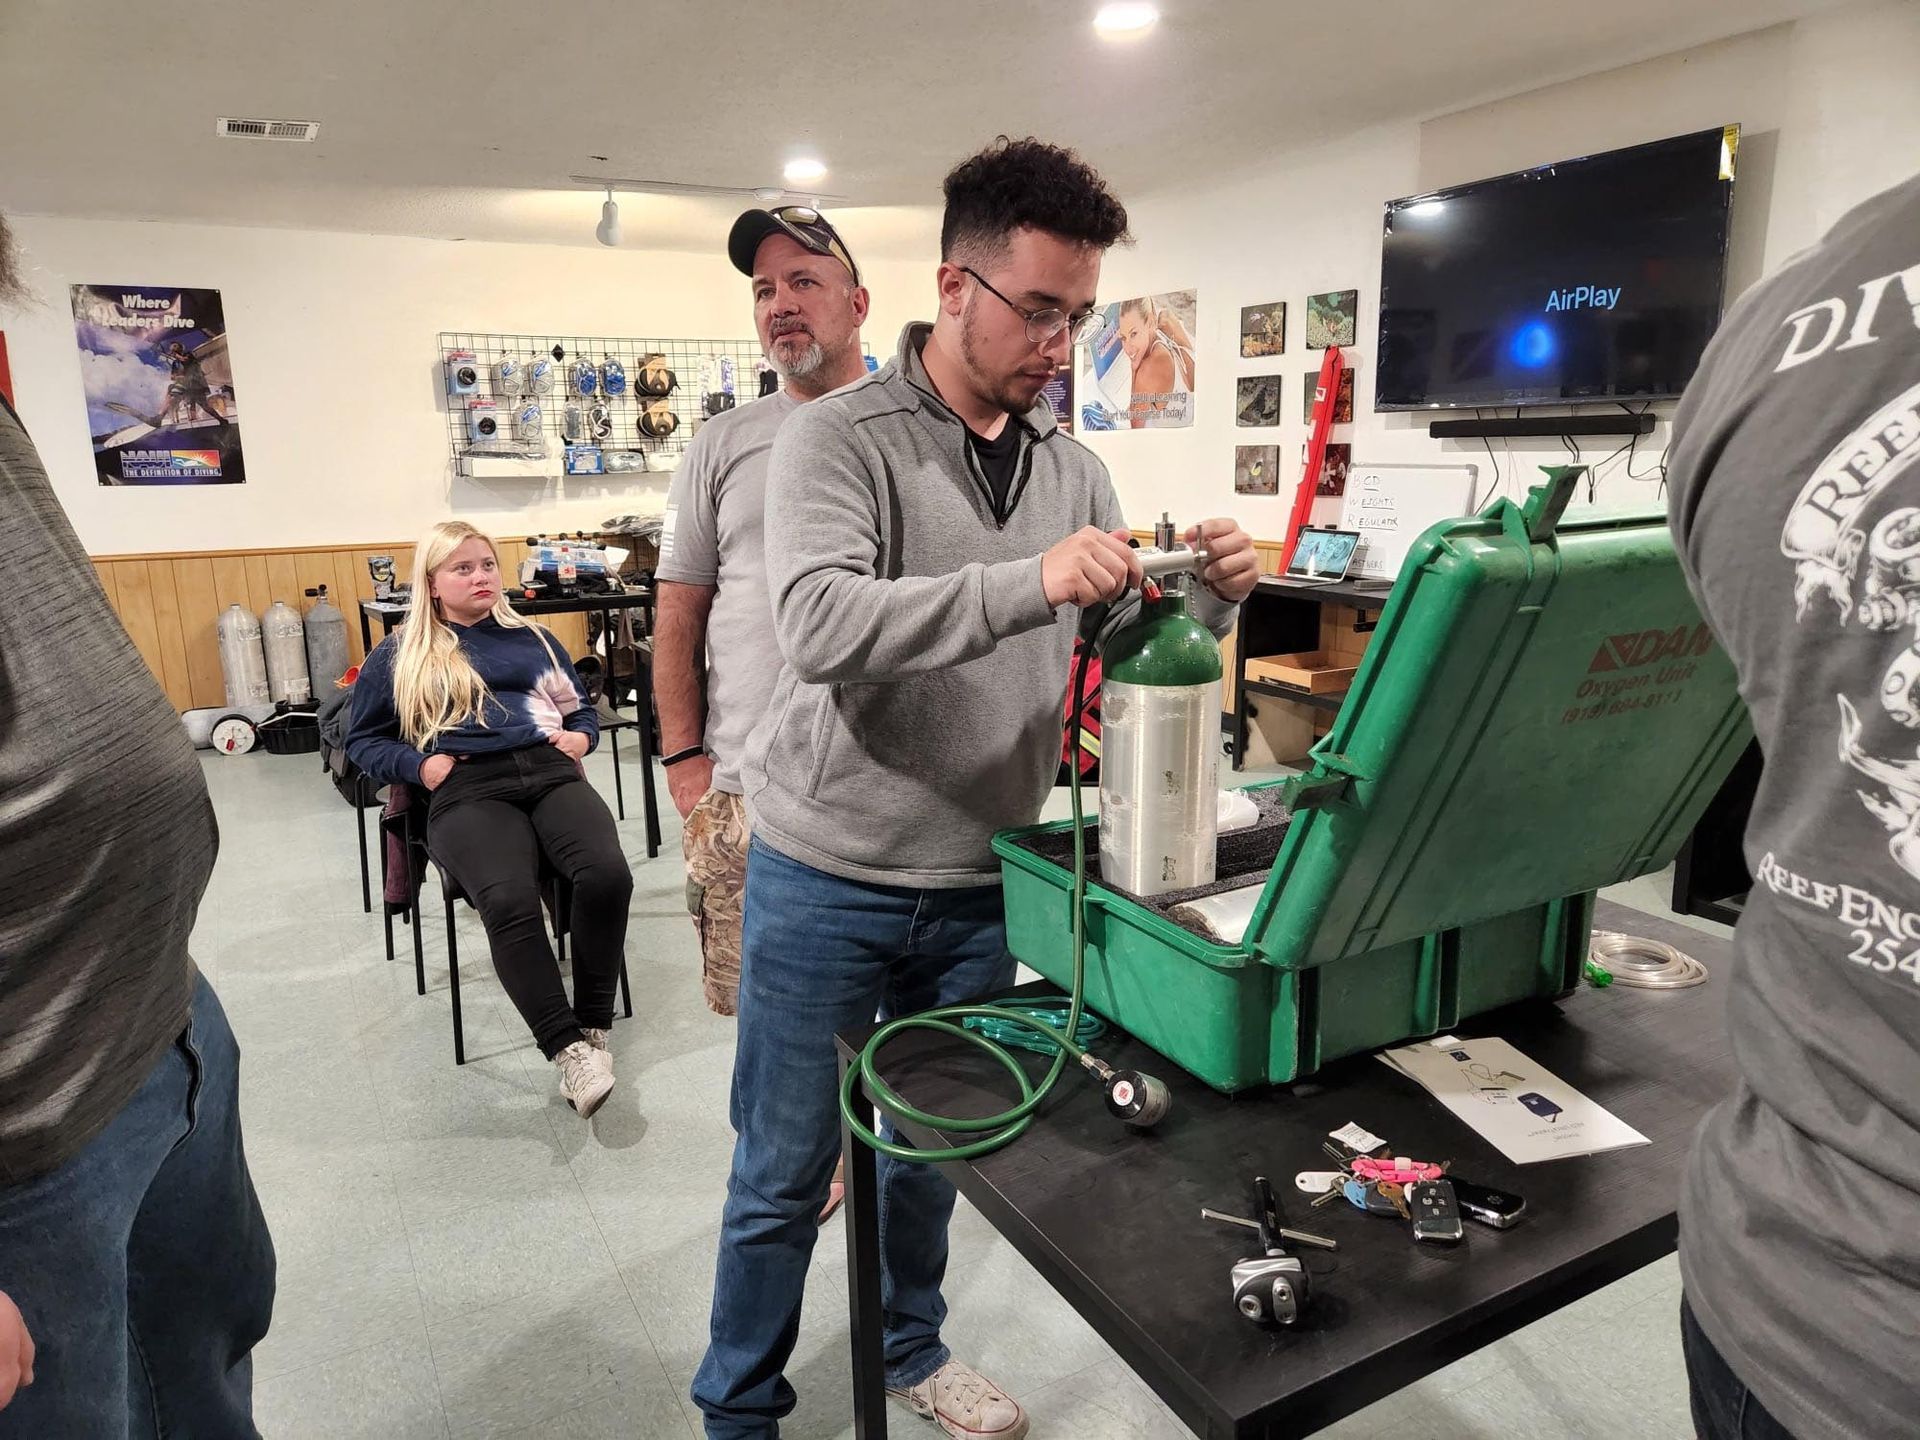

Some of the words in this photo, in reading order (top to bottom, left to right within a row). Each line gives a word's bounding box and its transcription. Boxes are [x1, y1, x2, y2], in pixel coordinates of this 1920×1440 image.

[121, 293, 170, 309] Where
[1545, 285, 1621, 312] AirPlay
[102, 313, 160, 328] Leaders
[163, 314, 195, 328] Dive
[1163, 406, 1187, 420] Today!
[140, 469, 181, 477] DEFINITION
[1803, 404, 1920, 526] REE
[1626, 622, 1714, 667] DAN
[1576, 674, 1650, 698] Oxygen
[1655, 662, 1697, 684] Unit
[1848, 929, 1920, 985] 254
